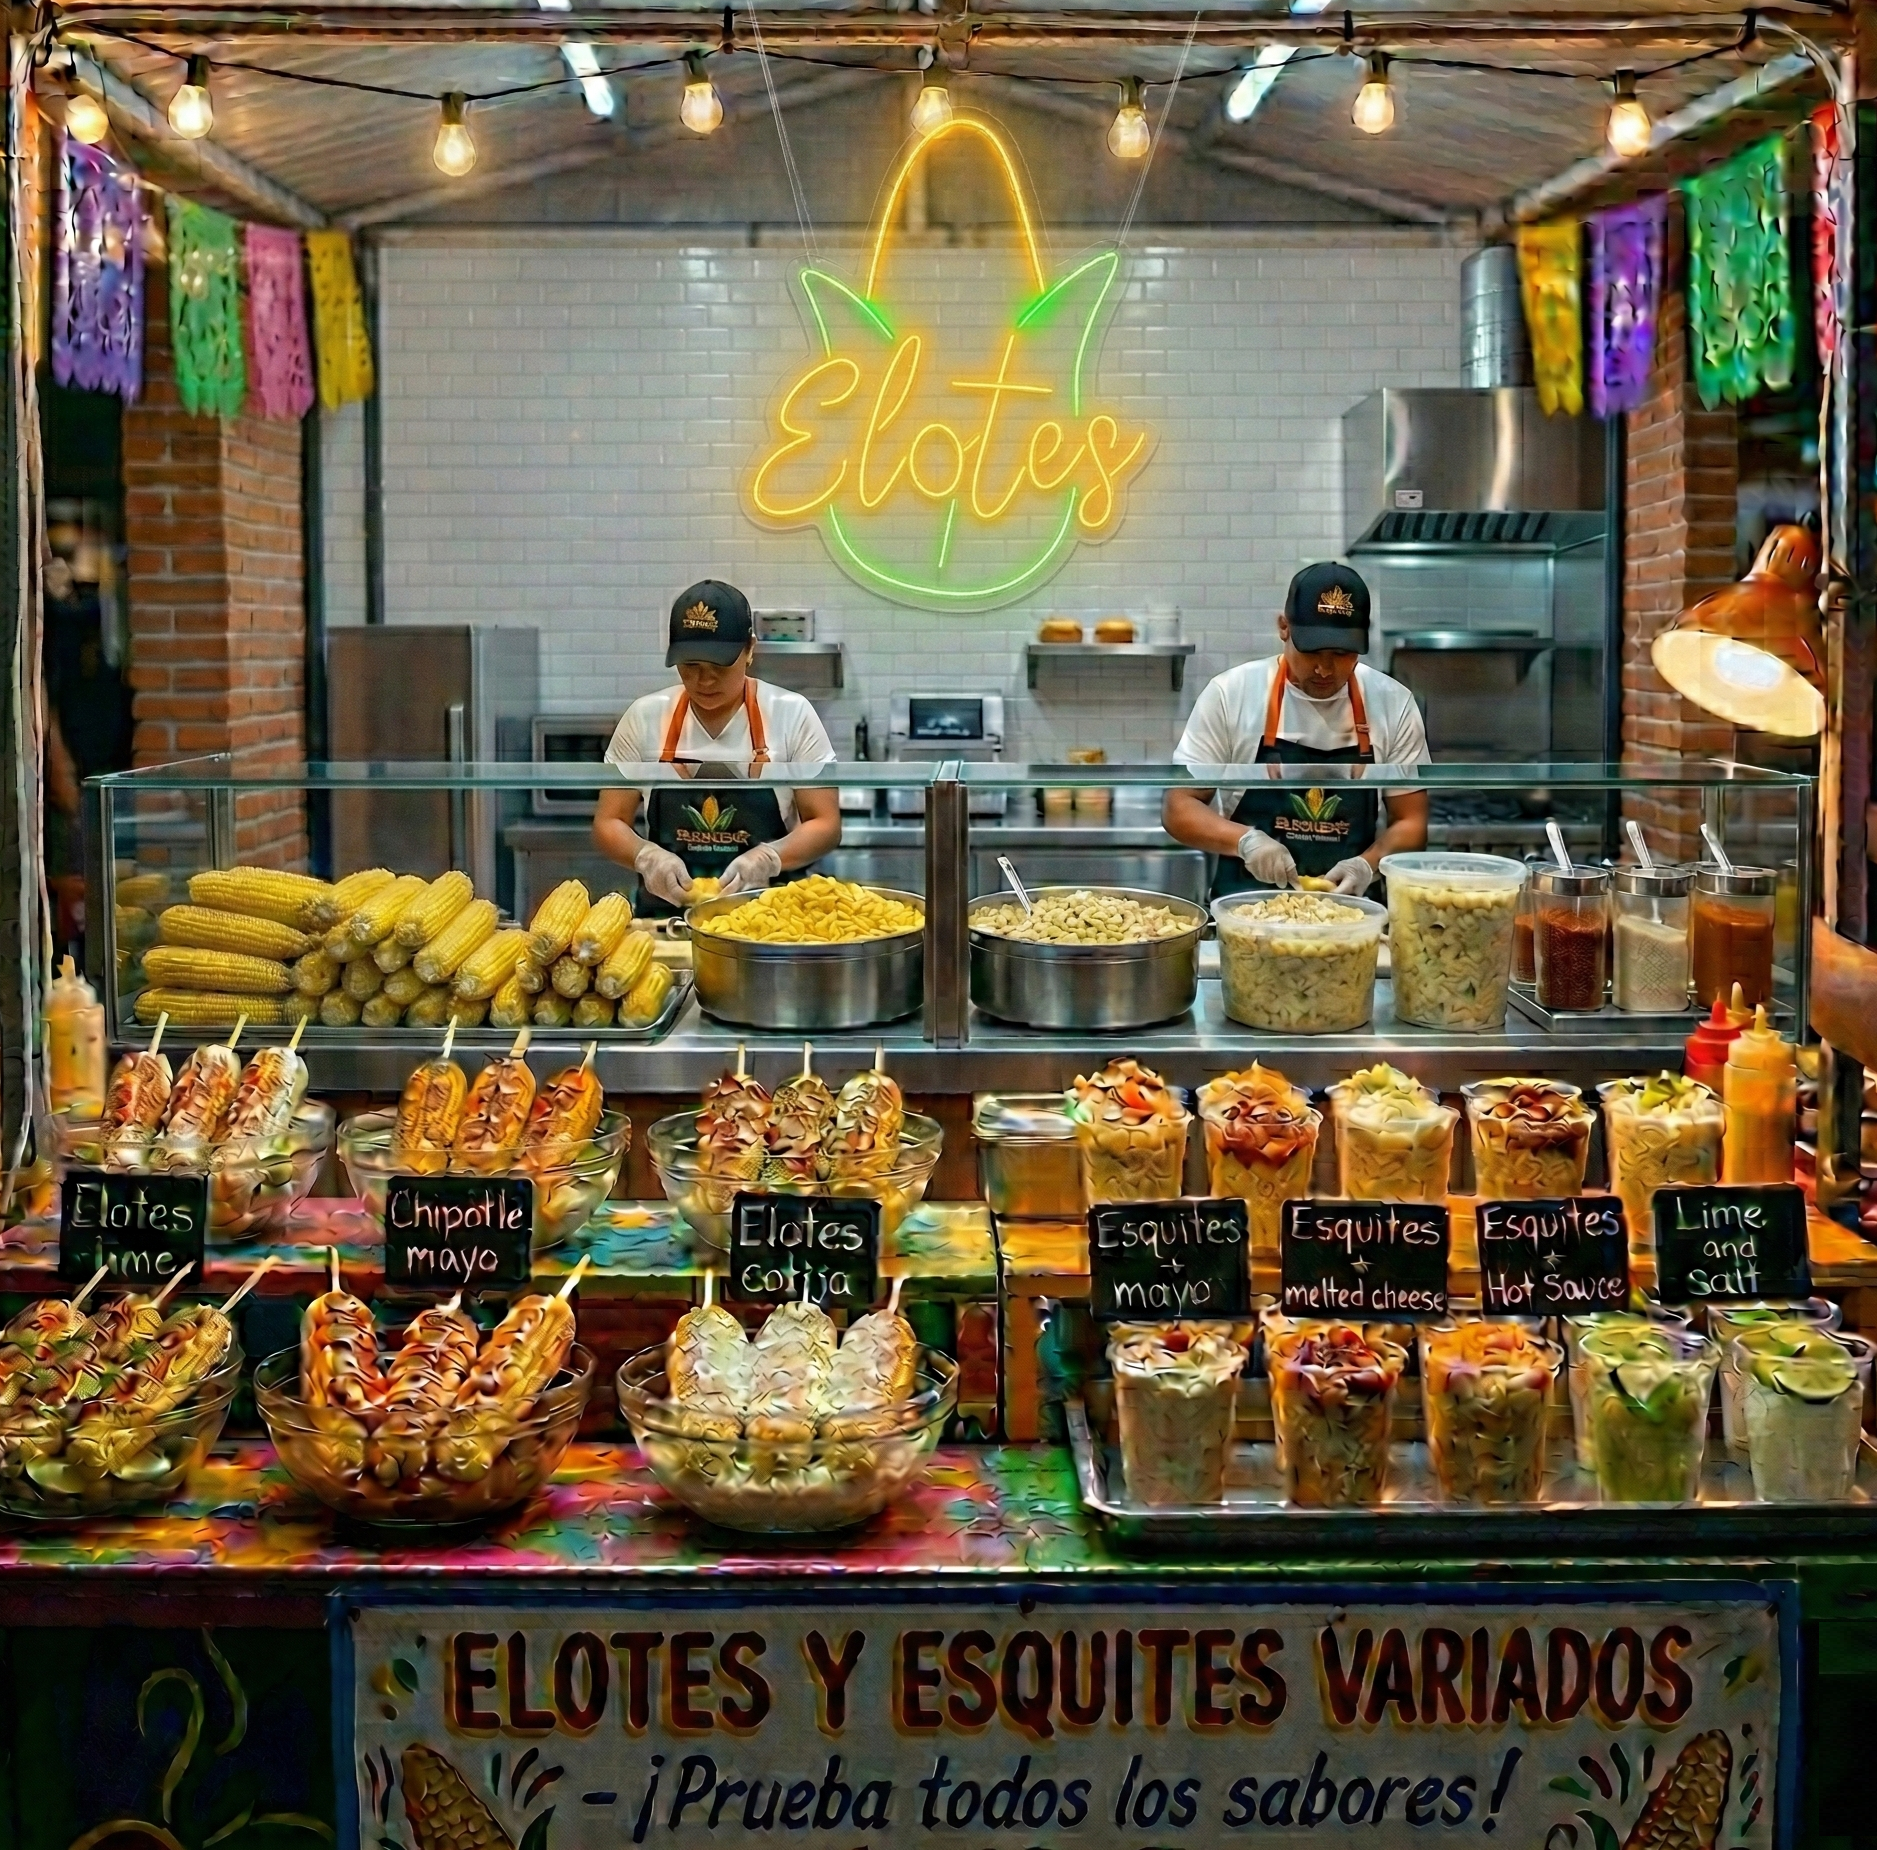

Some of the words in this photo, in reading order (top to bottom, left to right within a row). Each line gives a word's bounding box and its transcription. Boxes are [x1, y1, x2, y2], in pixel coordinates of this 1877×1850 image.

[753, 335, 1146, 528] Elotes
[71, 1183, 193, 1232] Elotes
[391, 1188, 523, 1242] Chipotle
[739, 1204, 863, 1251] Elotes
[1096, 1202, 1241, 1259] Esquites
[1290, 1206, 1441, 1254] Esquites
[1483, 1198, 1620, 1254] Esquites
[1676, 1196, 1767, 1230] Lime
[407, 1245, 499, 1283] mayo
[1703, 1235, 1758, 1259] and
[1113, 1279, 1211, 1317] mayo
[1285, 1276, 1364, 1308] melted
[1371, 1280, 1446, 1312] cheese
[1487, 1269, 1536, 1312] Hot
[1543, 1273, 1626, 1301] Sauce
[449, 1630, 771, 1733] ELOTES
[804, 1629, 867, 1731] Y
[899, 1628, 1288, 1739] ESQUITES
[1318, 1625, 1695, 1724] VARIADOS
[632, 1754, 894, 1844] ¡Prueba
[918, 1754, 1093, 1829] todos
[1114, 1753, 1201, 1830] los
[1221, 1746, 1523, 1835] sabores!
